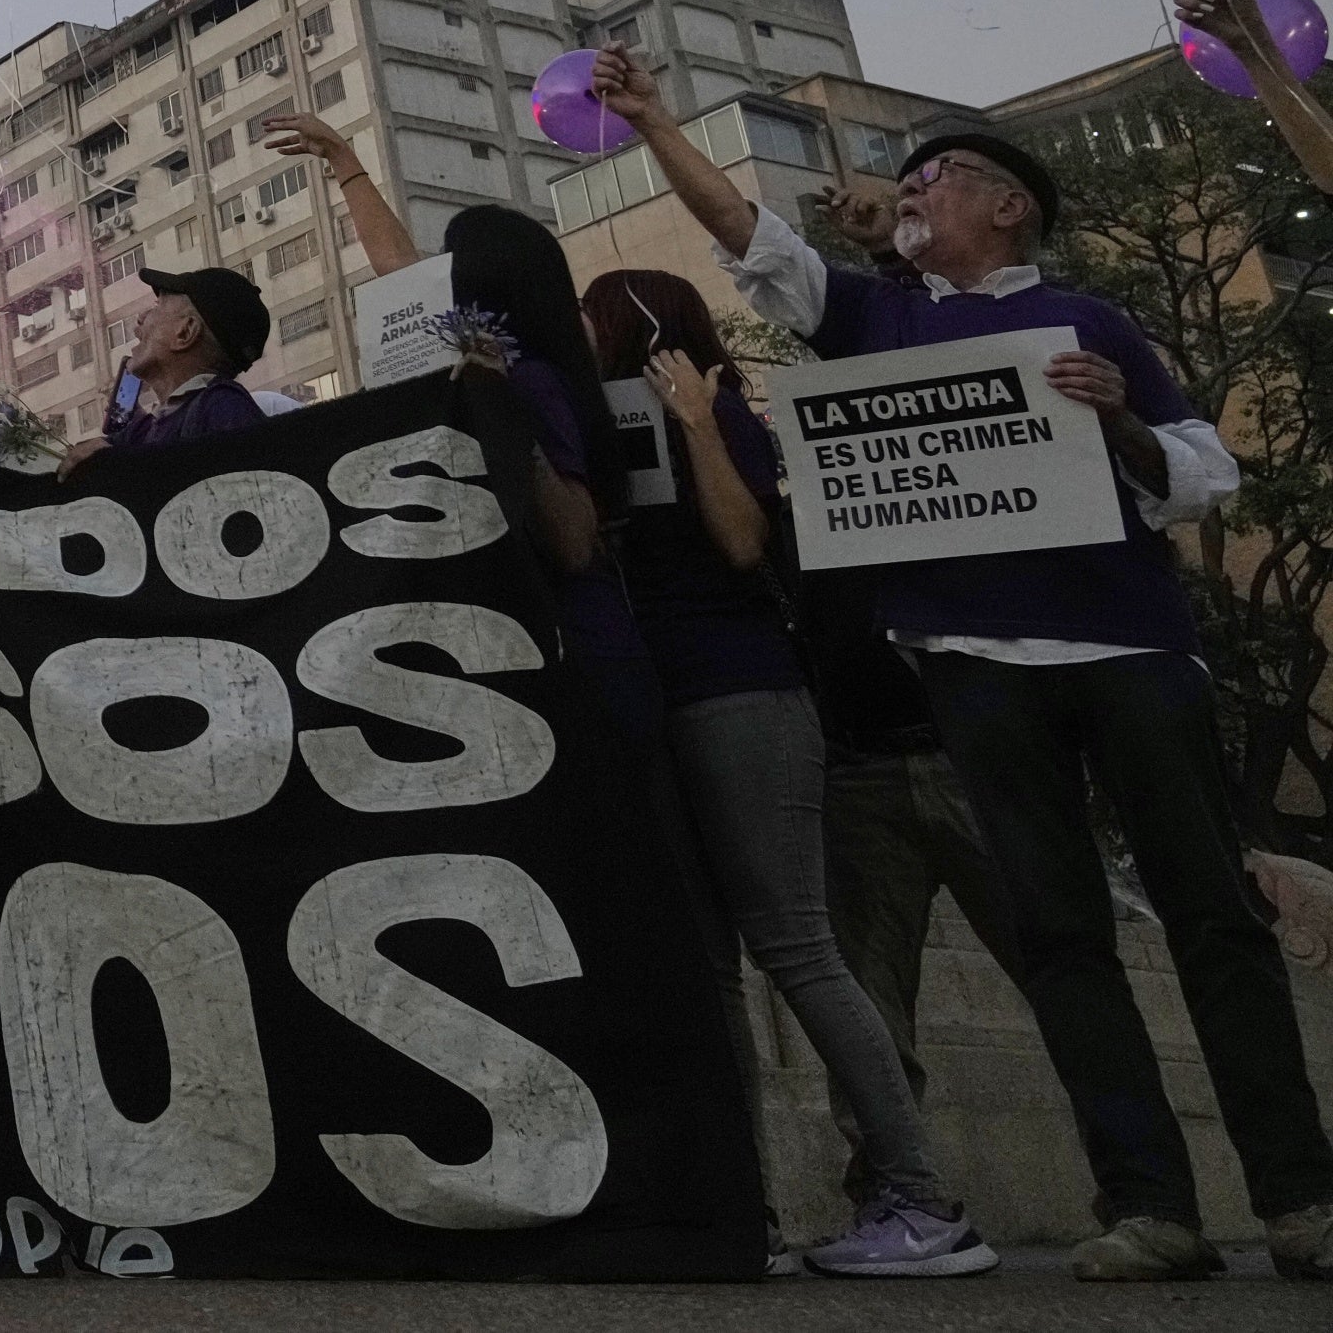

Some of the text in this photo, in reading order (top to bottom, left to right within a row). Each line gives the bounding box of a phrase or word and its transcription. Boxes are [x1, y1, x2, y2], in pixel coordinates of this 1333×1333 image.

[382, 301, 424, 328] JESÚS
[380, 315, 430, 346] ARMAS
[372, 338, 441, 369] DERECHOS HUMANO
[383, 337, 419, 356] DEFENSOR
[372, 353, 421, 378] SECUESTRADO
[420, 347, 436, 358] POR
[390, 359, 430, 380] DICTADURA
[803, 378, 1015, 430] LA TORTURA
[815, 416, 1053, 470] ES UN CRIMEN
[822, 462, 959, 501] DE LESA
[826, 486, 1038, 532] HUMANIDAD
